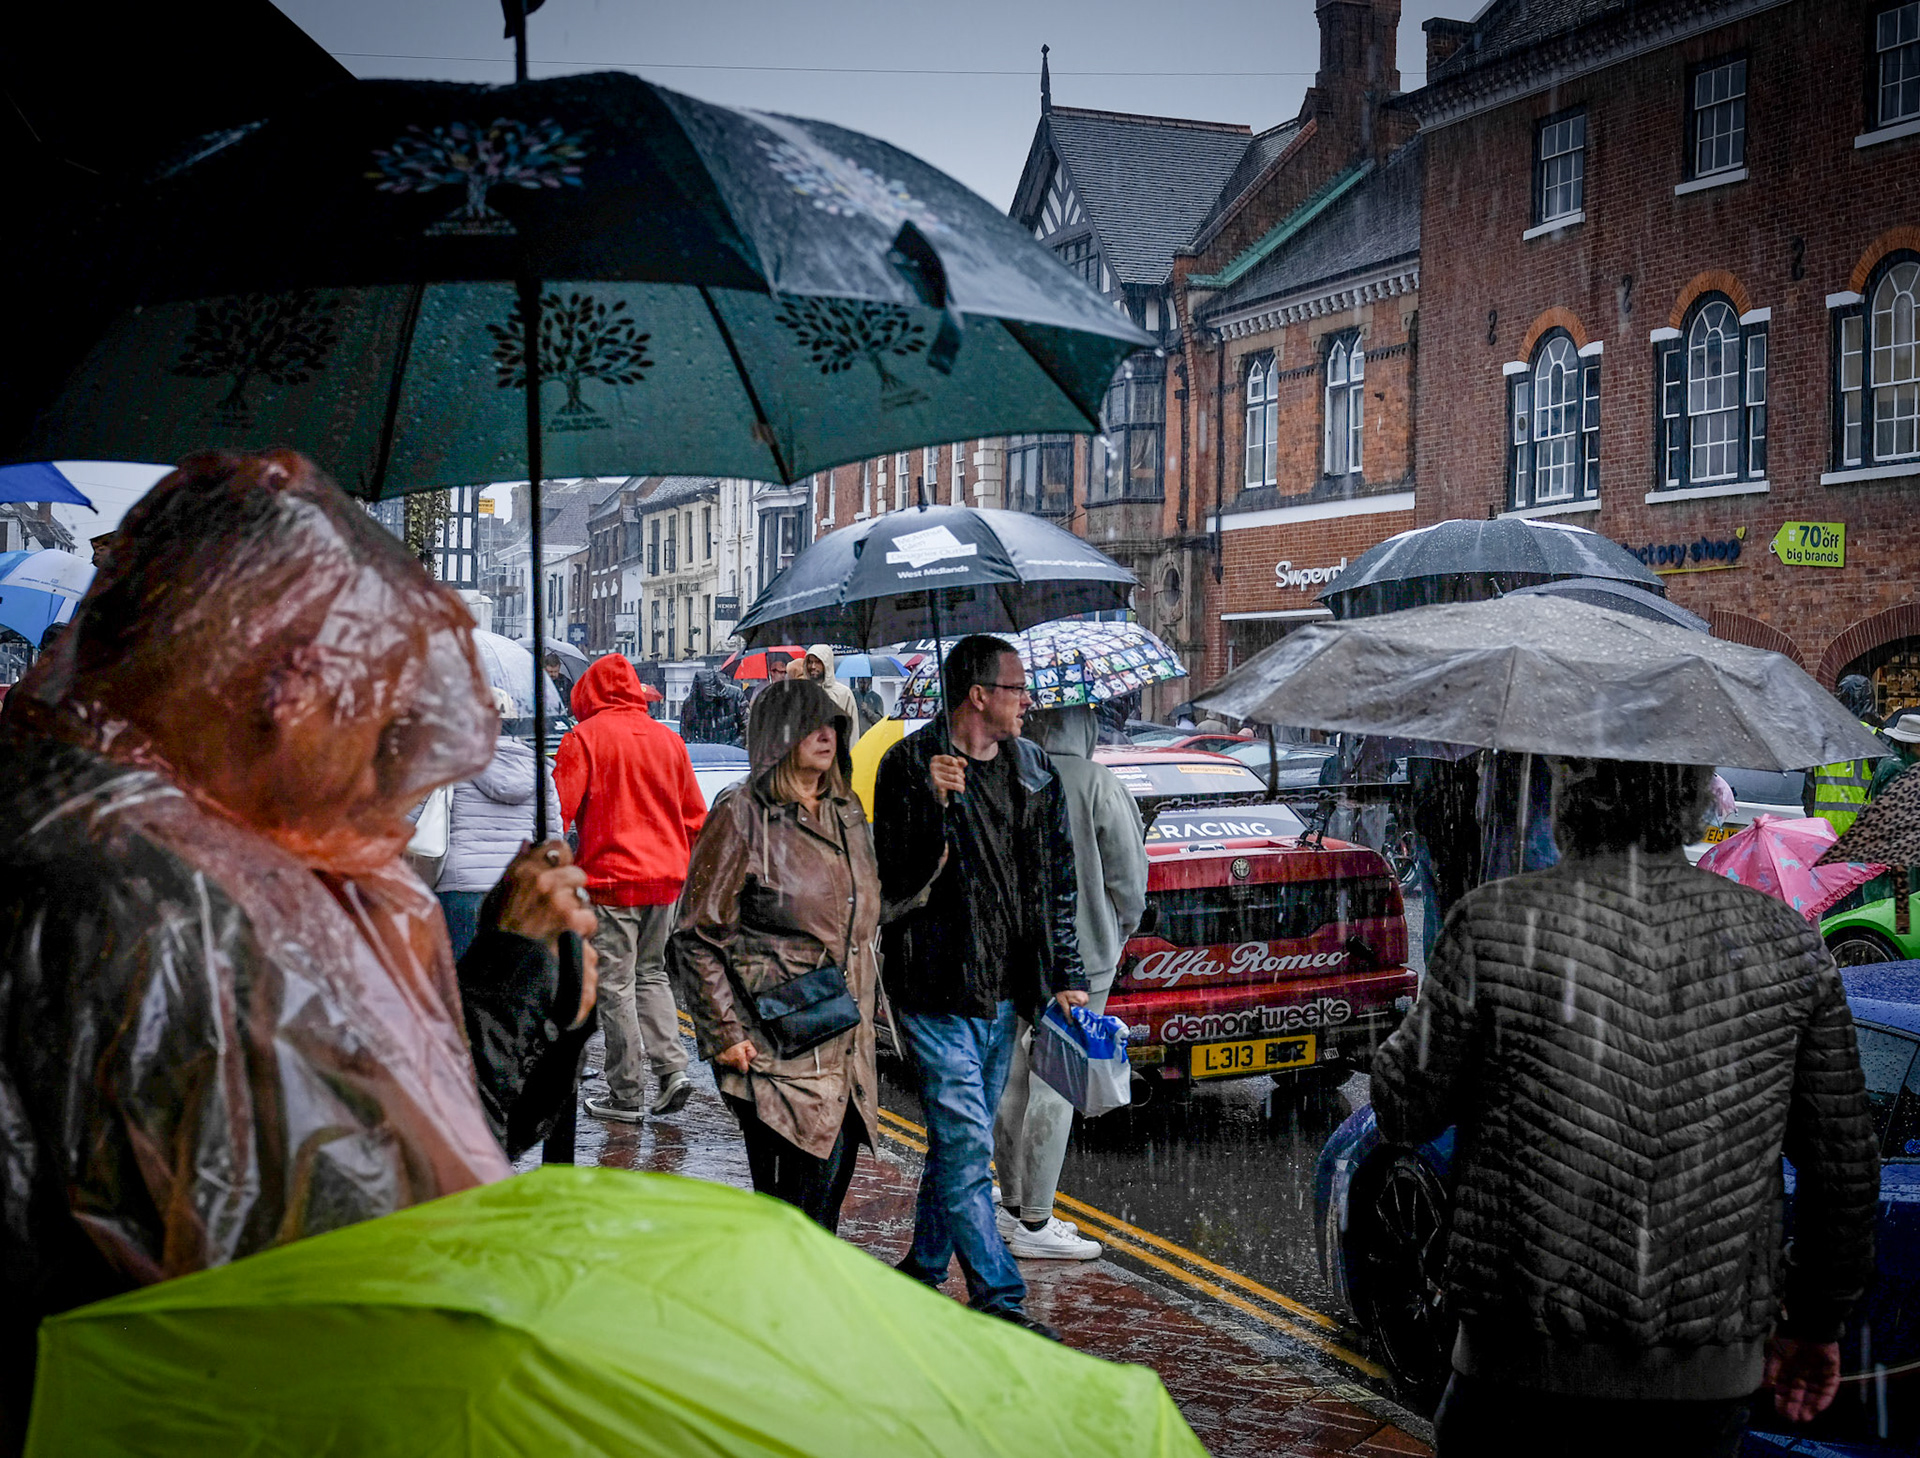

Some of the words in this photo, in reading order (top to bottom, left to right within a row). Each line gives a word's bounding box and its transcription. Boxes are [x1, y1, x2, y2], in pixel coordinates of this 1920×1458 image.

[1690, 536, 1741, 565] shop
[1822, 534, 1840, 548] off
[1787, 548, 1802, 563] big
[1804, 549, 1839, 563] brands
[896, 570, 922, 579] West
[923, 565, 970, 577] Midlands
[1132, 949, 1225, 988] Alfa
[1227, 942, 1350, 975] Romeo
[1205, 1046, 1254, 1071] L313
